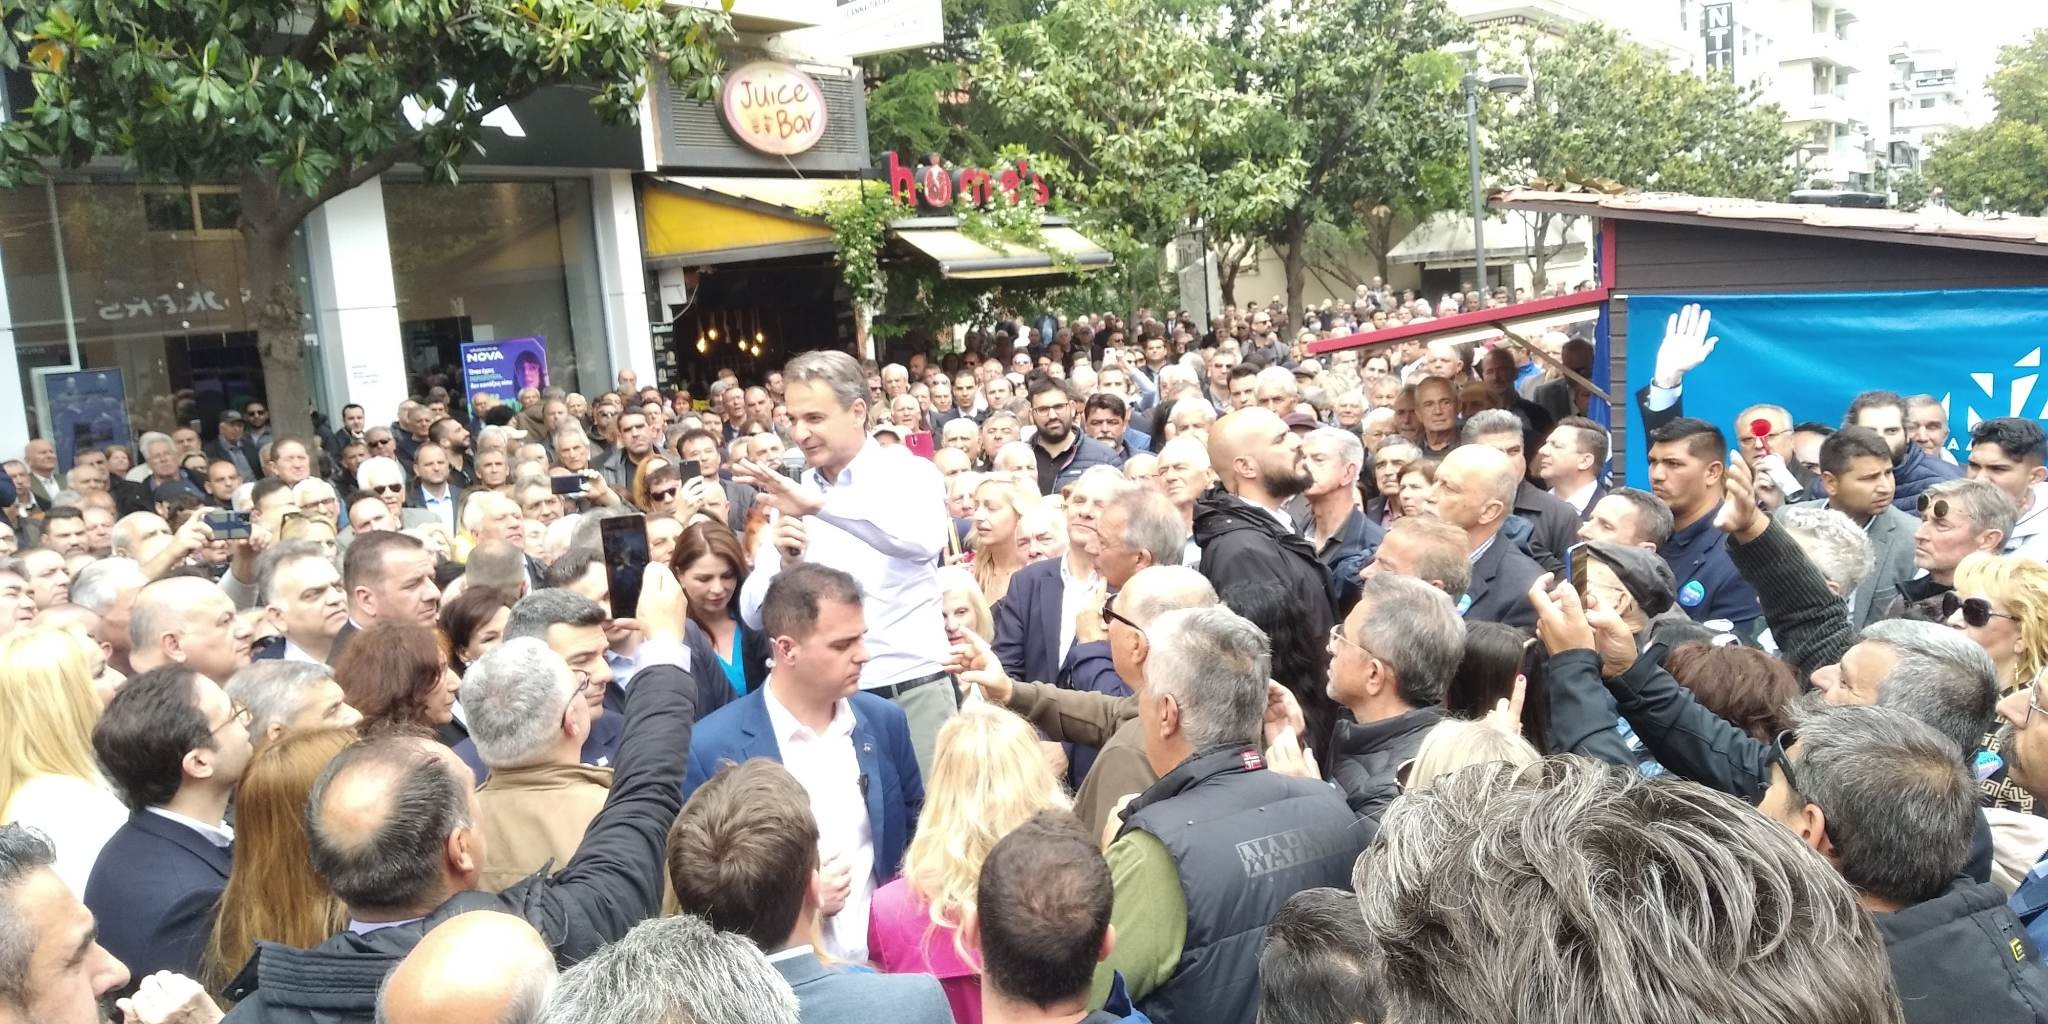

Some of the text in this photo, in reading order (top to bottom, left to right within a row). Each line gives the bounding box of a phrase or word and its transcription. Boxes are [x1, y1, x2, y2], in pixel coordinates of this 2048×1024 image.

[740, 81, 809, 109] Juice
[776, 109, 815, 140] Bar
[466, 351, 504, 363] NOVA
